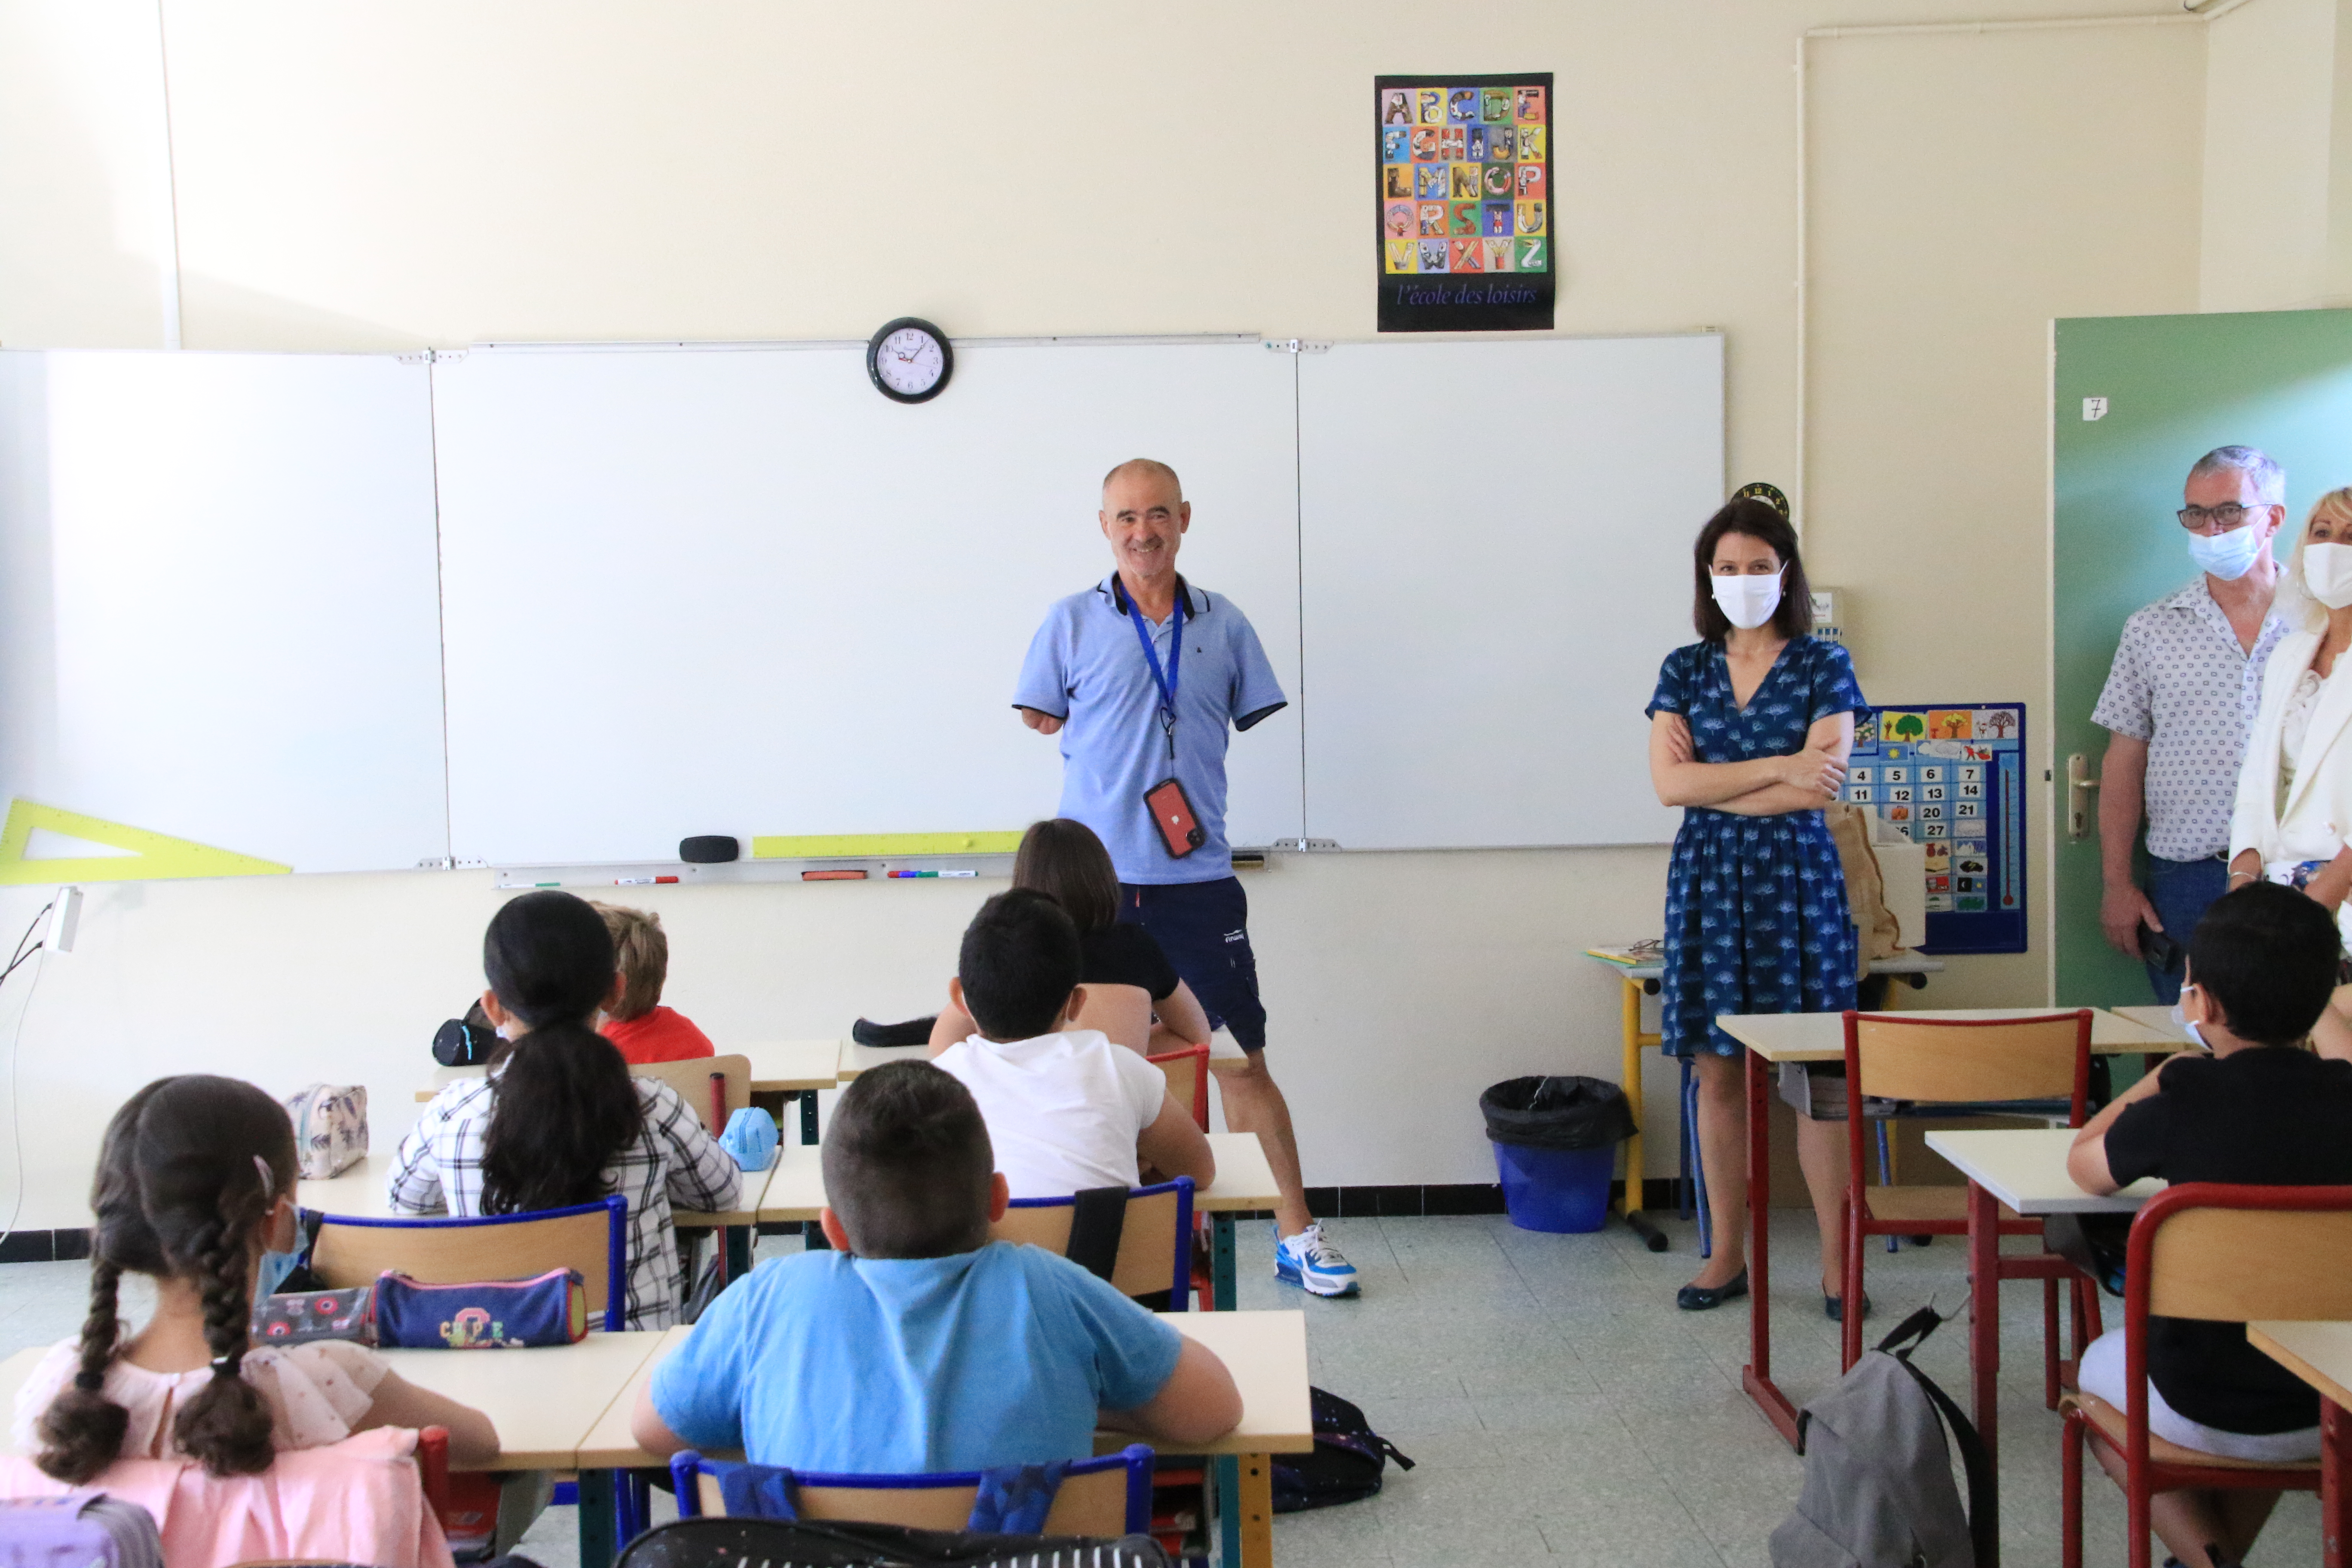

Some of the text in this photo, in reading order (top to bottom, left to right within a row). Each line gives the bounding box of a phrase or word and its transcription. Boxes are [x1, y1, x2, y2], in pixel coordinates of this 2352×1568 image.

[1385, 90, 1539, 124] A B C D E
[1386, 131, 1406, 160] F
[1413, 129, 1436, 160] G
[1442, 129, 1463, 159] H
[1521, 128, 1542, 159] K
[1387, 166, 1541, 198] L M N O P
[1421, 205, 1444, 235] R
[1454, 203, 1476, 235] S
[1486, 205, 1510, 233] T
[1517, 203, 1543, 233] U
[1388, 239, 1542, 270] V W X Y Z
[1455, 283, 1484, 304] des
[1487, 283, 1537, 304] loisirs
[2091, 399, 2101, 418] 7
[1857, 769, 1974, 781] 4 5 6 7
[1855, 785, 1978, 800] 11 12 13 14
[1923, 805, 1974, 818] 20 21
[1896, 826, 1944, 836] 6 27
